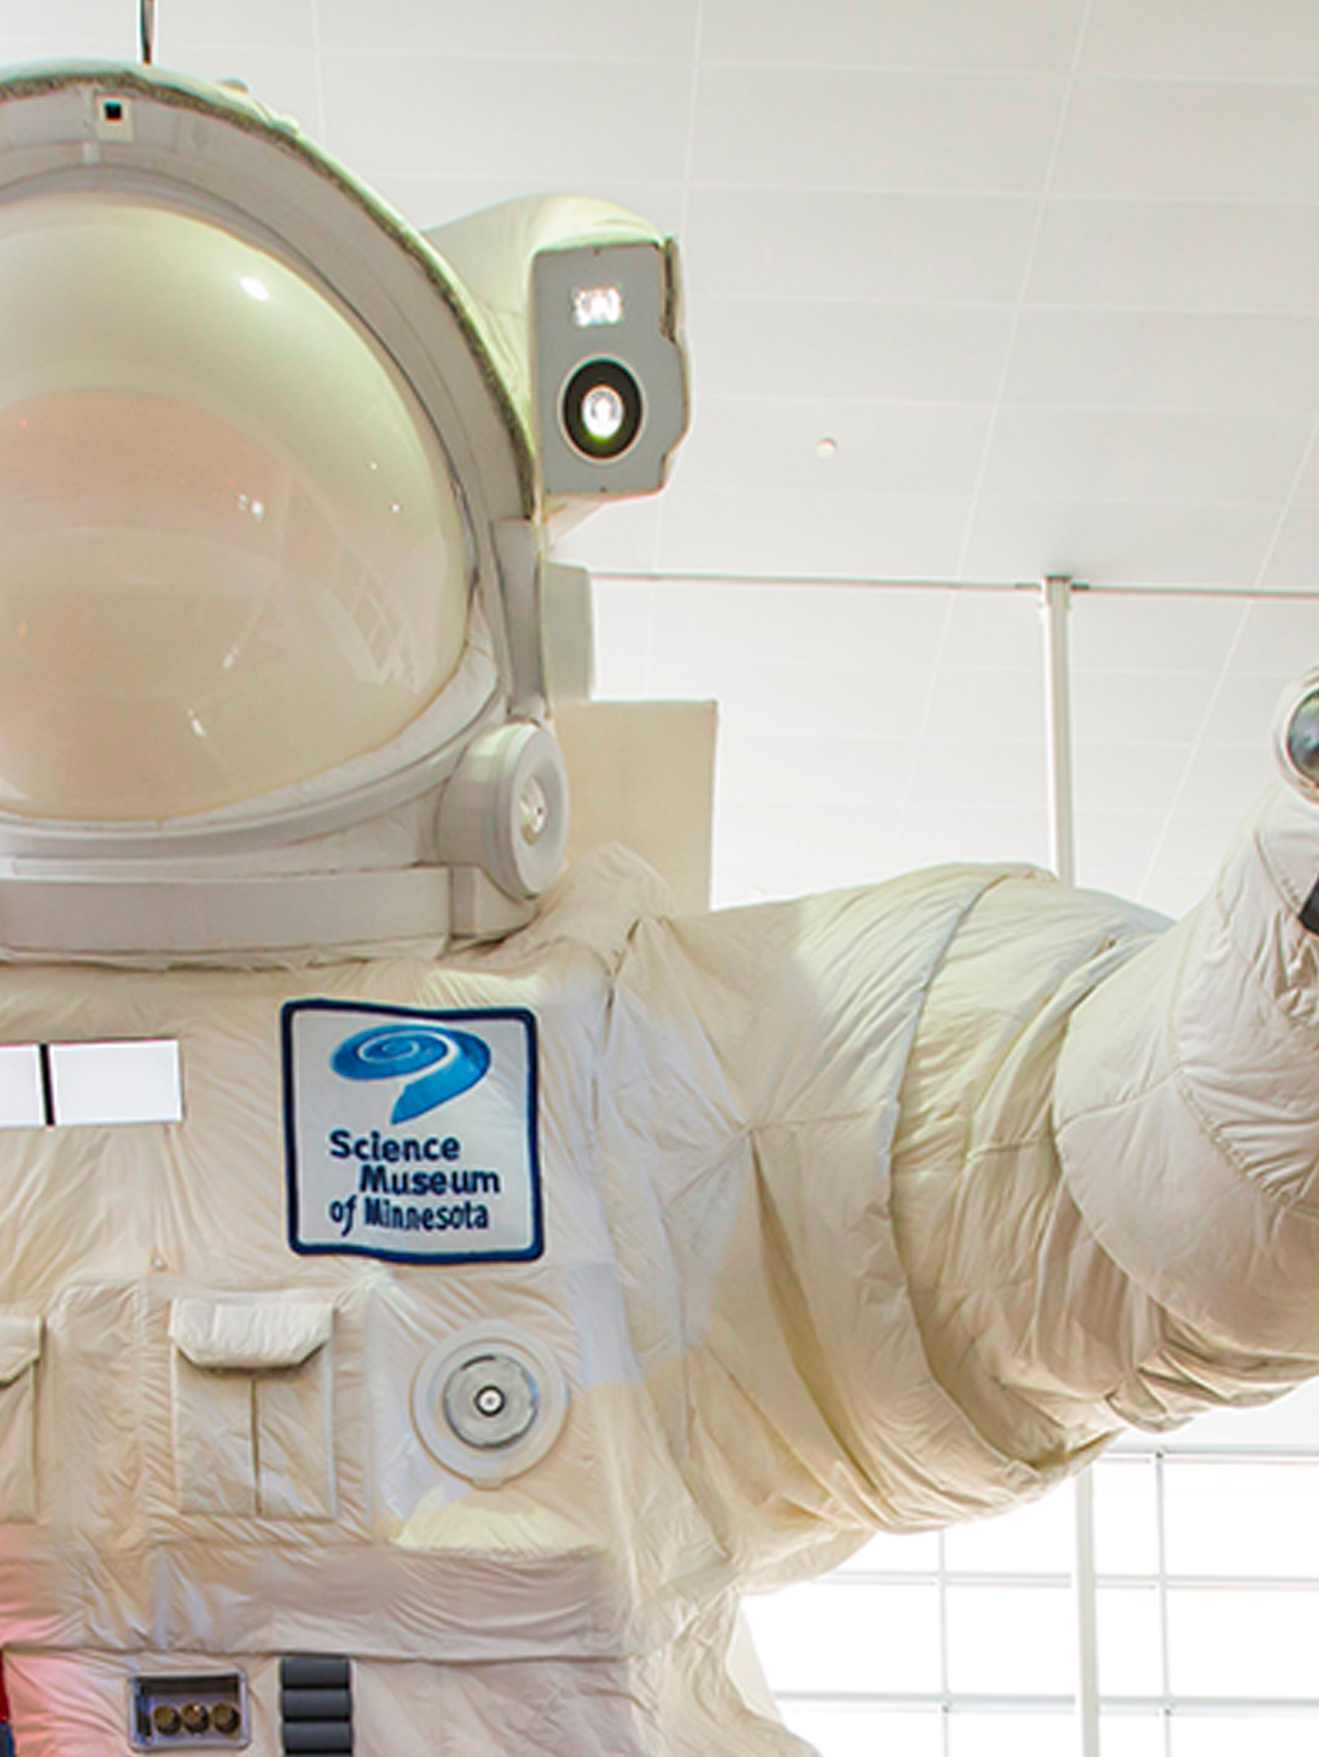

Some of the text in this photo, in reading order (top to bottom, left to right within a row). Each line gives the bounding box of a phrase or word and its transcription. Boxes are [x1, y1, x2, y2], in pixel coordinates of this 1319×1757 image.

[329, 1129, 460, 1162] Science
[359, 1164, 500, 1195] Museum
[329, 1195, 488, 1236] of Minnesota
